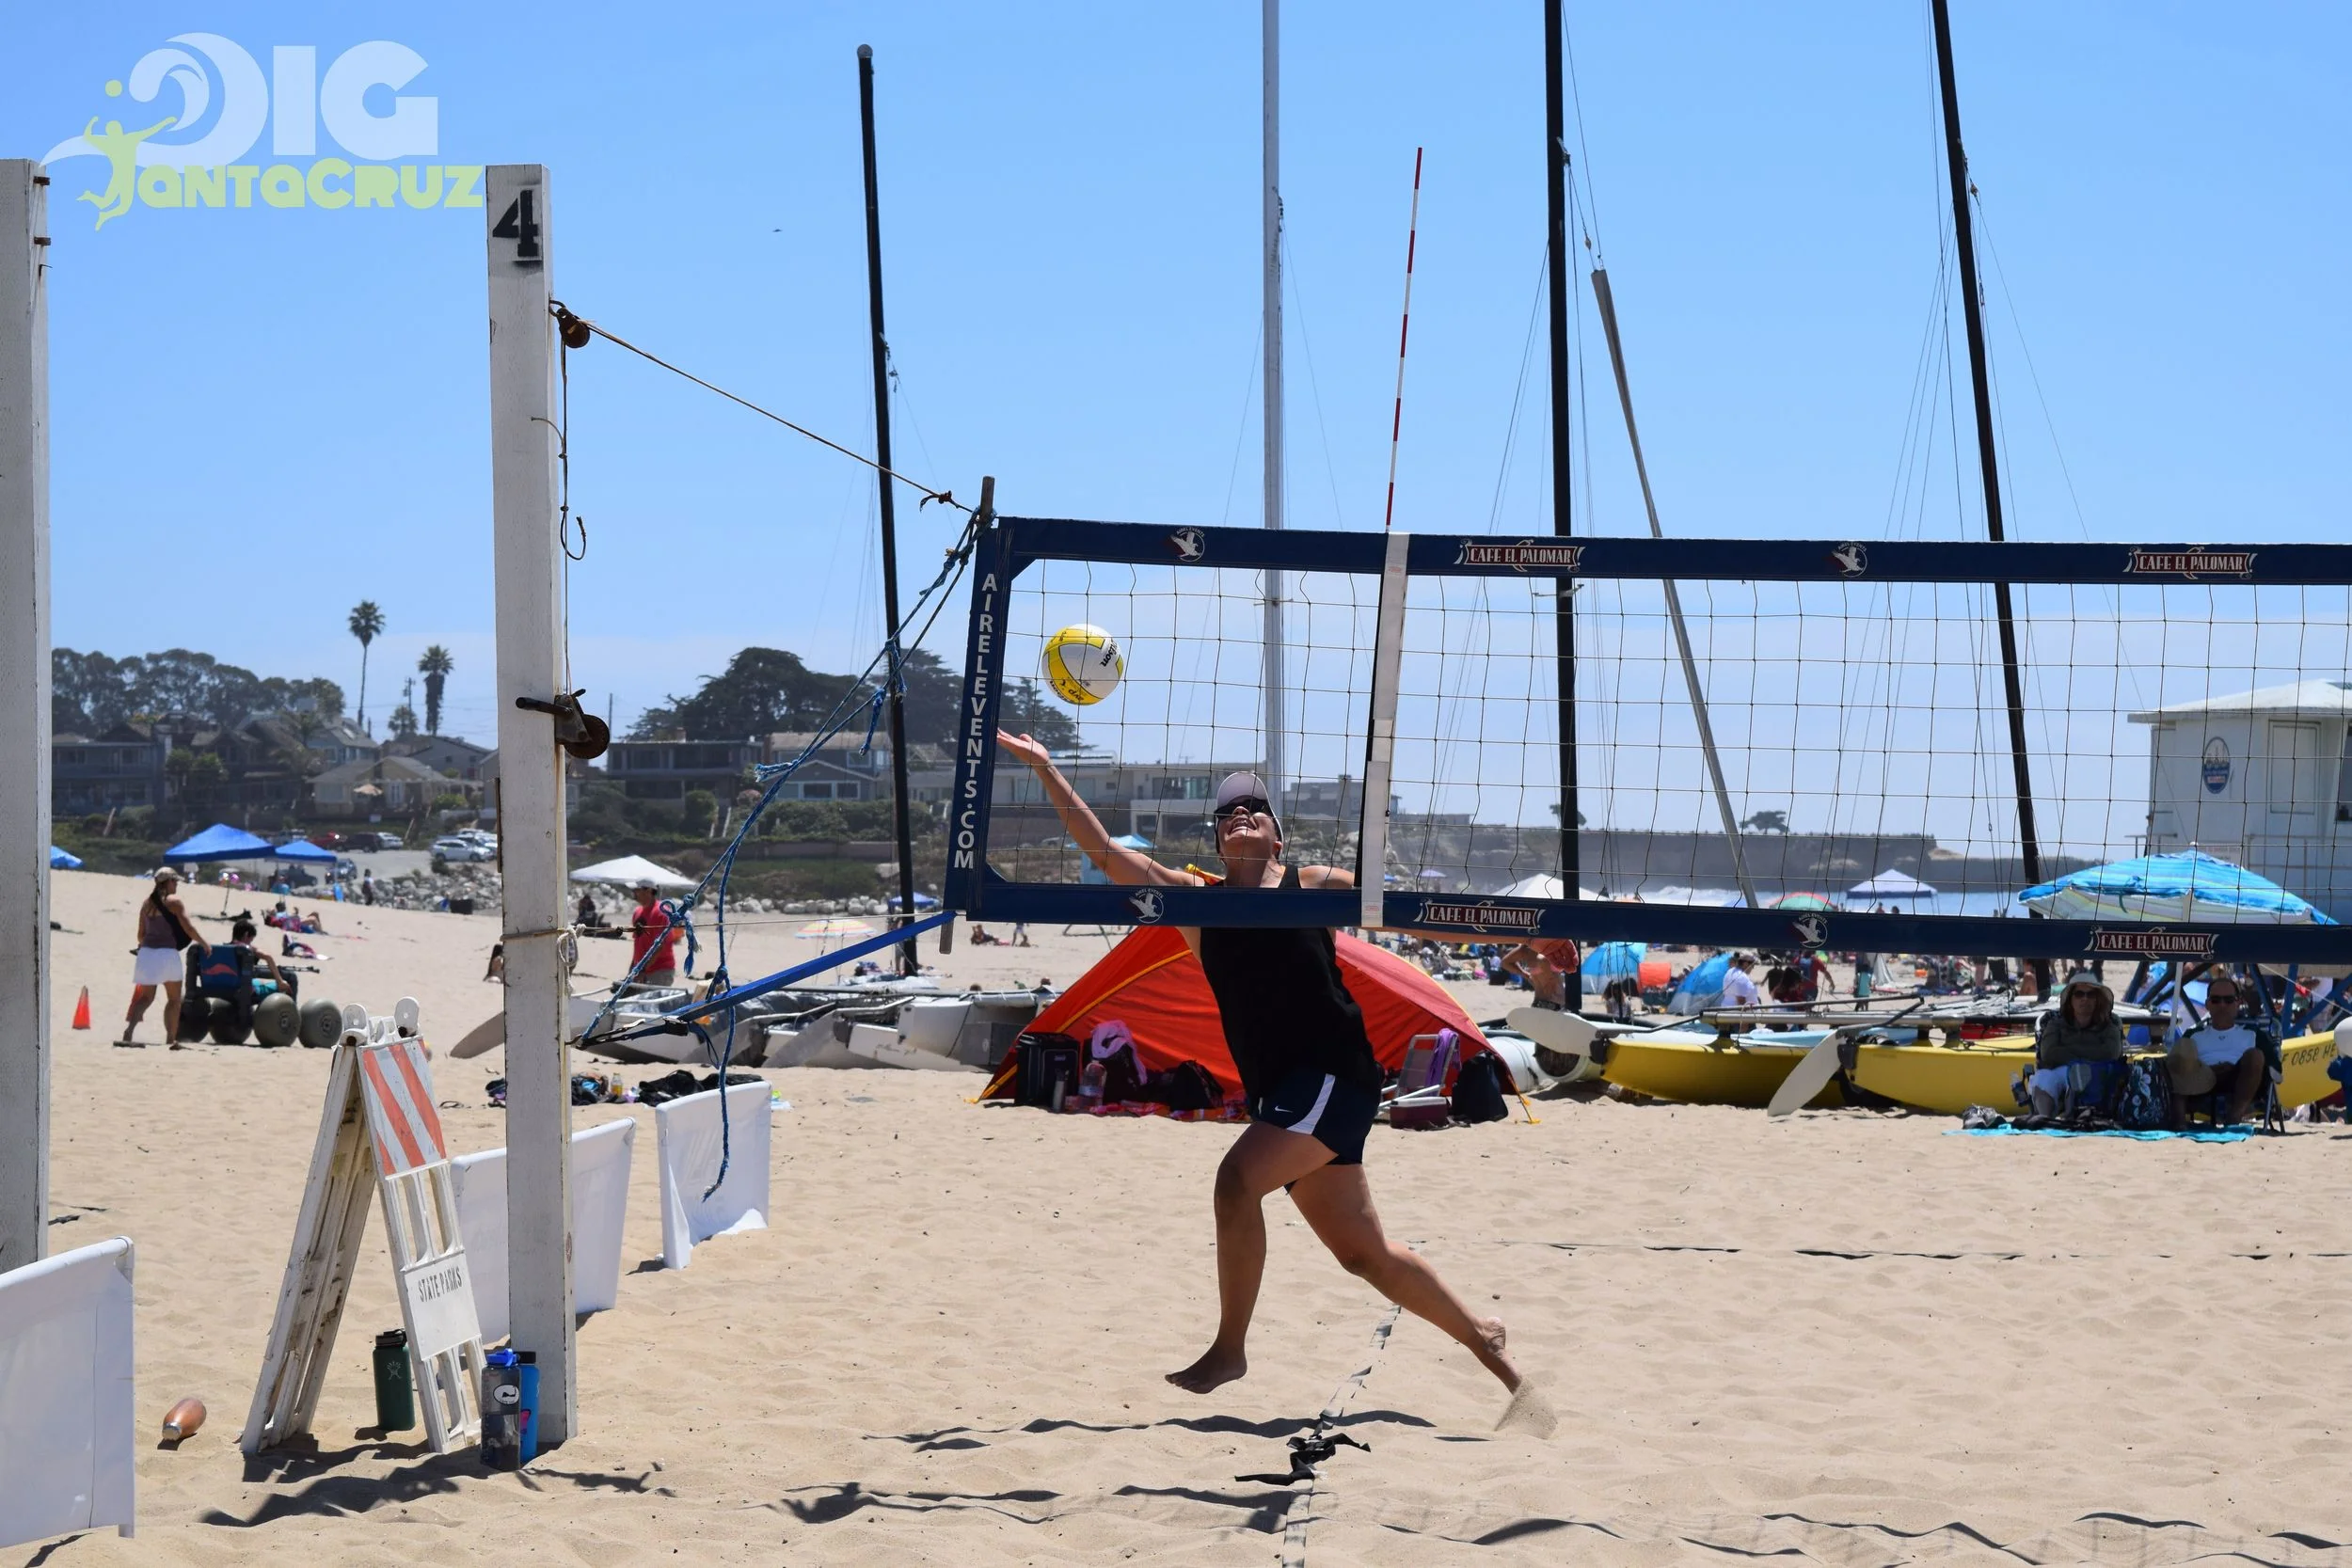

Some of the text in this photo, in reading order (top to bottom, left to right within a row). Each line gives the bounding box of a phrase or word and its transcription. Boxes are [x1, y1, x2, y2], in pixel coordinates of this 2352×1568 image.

[492, 190, 540, 258] 4
[1470, 547, 1571, 563] CAFE EL PALOMAR
[2139, 555, 2243, 571] CAFE EL PALOMAR
[954, 573, 997, 869] AIRELEVENTS.COM
[1430, 907, 1531, 926] CAFE EL PALOMAR
[2101, 935, 2204, 951] CAFE EL PALOMAR
[418, 1266, 462, 1302] STATE PARKS
